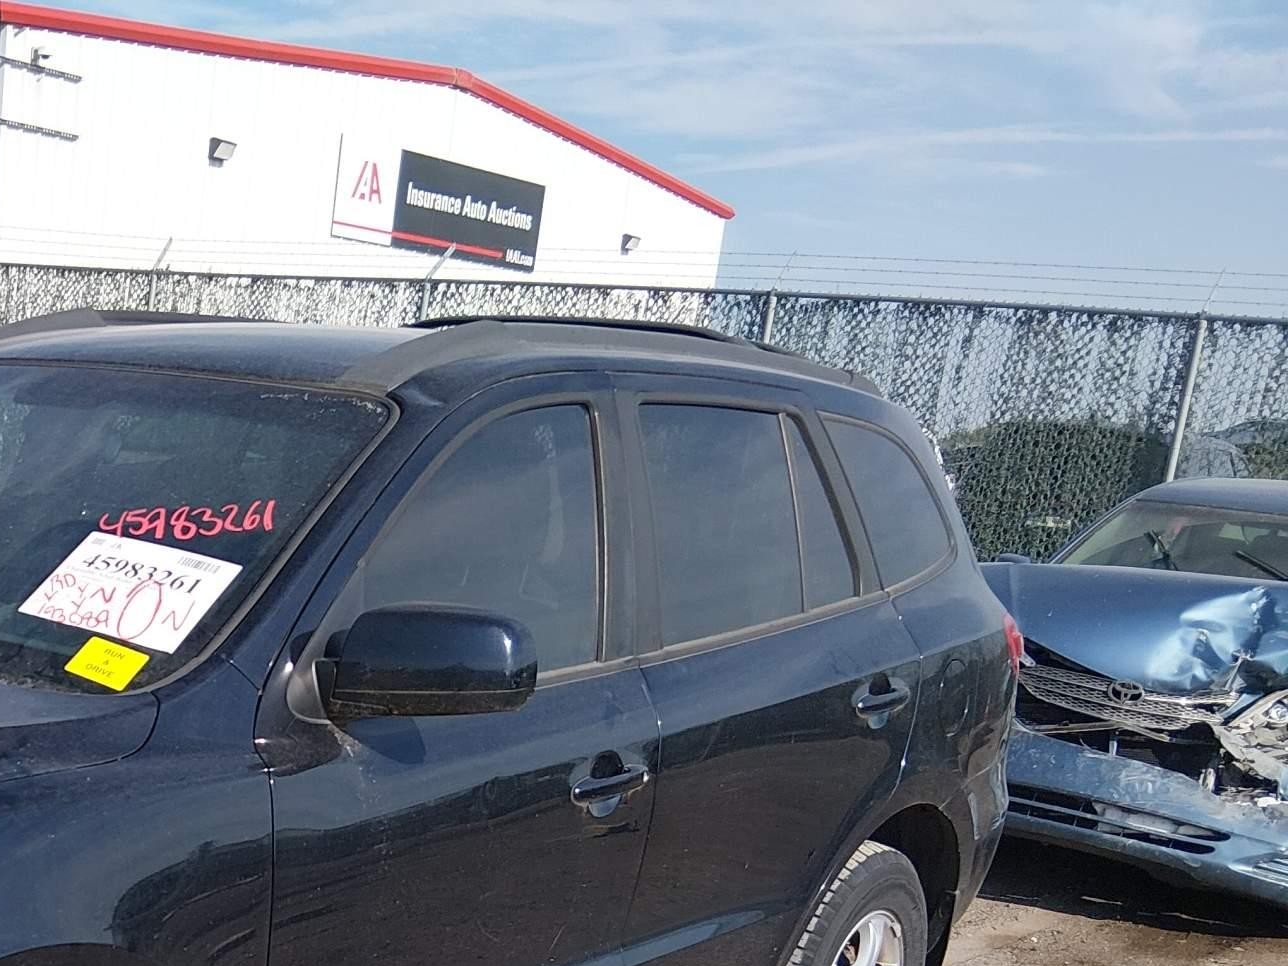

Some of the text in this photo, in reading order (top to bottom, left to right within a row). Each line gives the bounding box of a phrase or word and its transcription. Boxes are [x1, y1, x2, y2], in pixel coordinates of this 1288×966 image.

[406, 181, 533, 231] Insurance Auto Auctions
[99, 500, 276, 540] 45983261
[82, 553, 202, 594] 45983261
[85, 663, 115, 678] DRIVE
[104, 648, 126, 660] RUN
